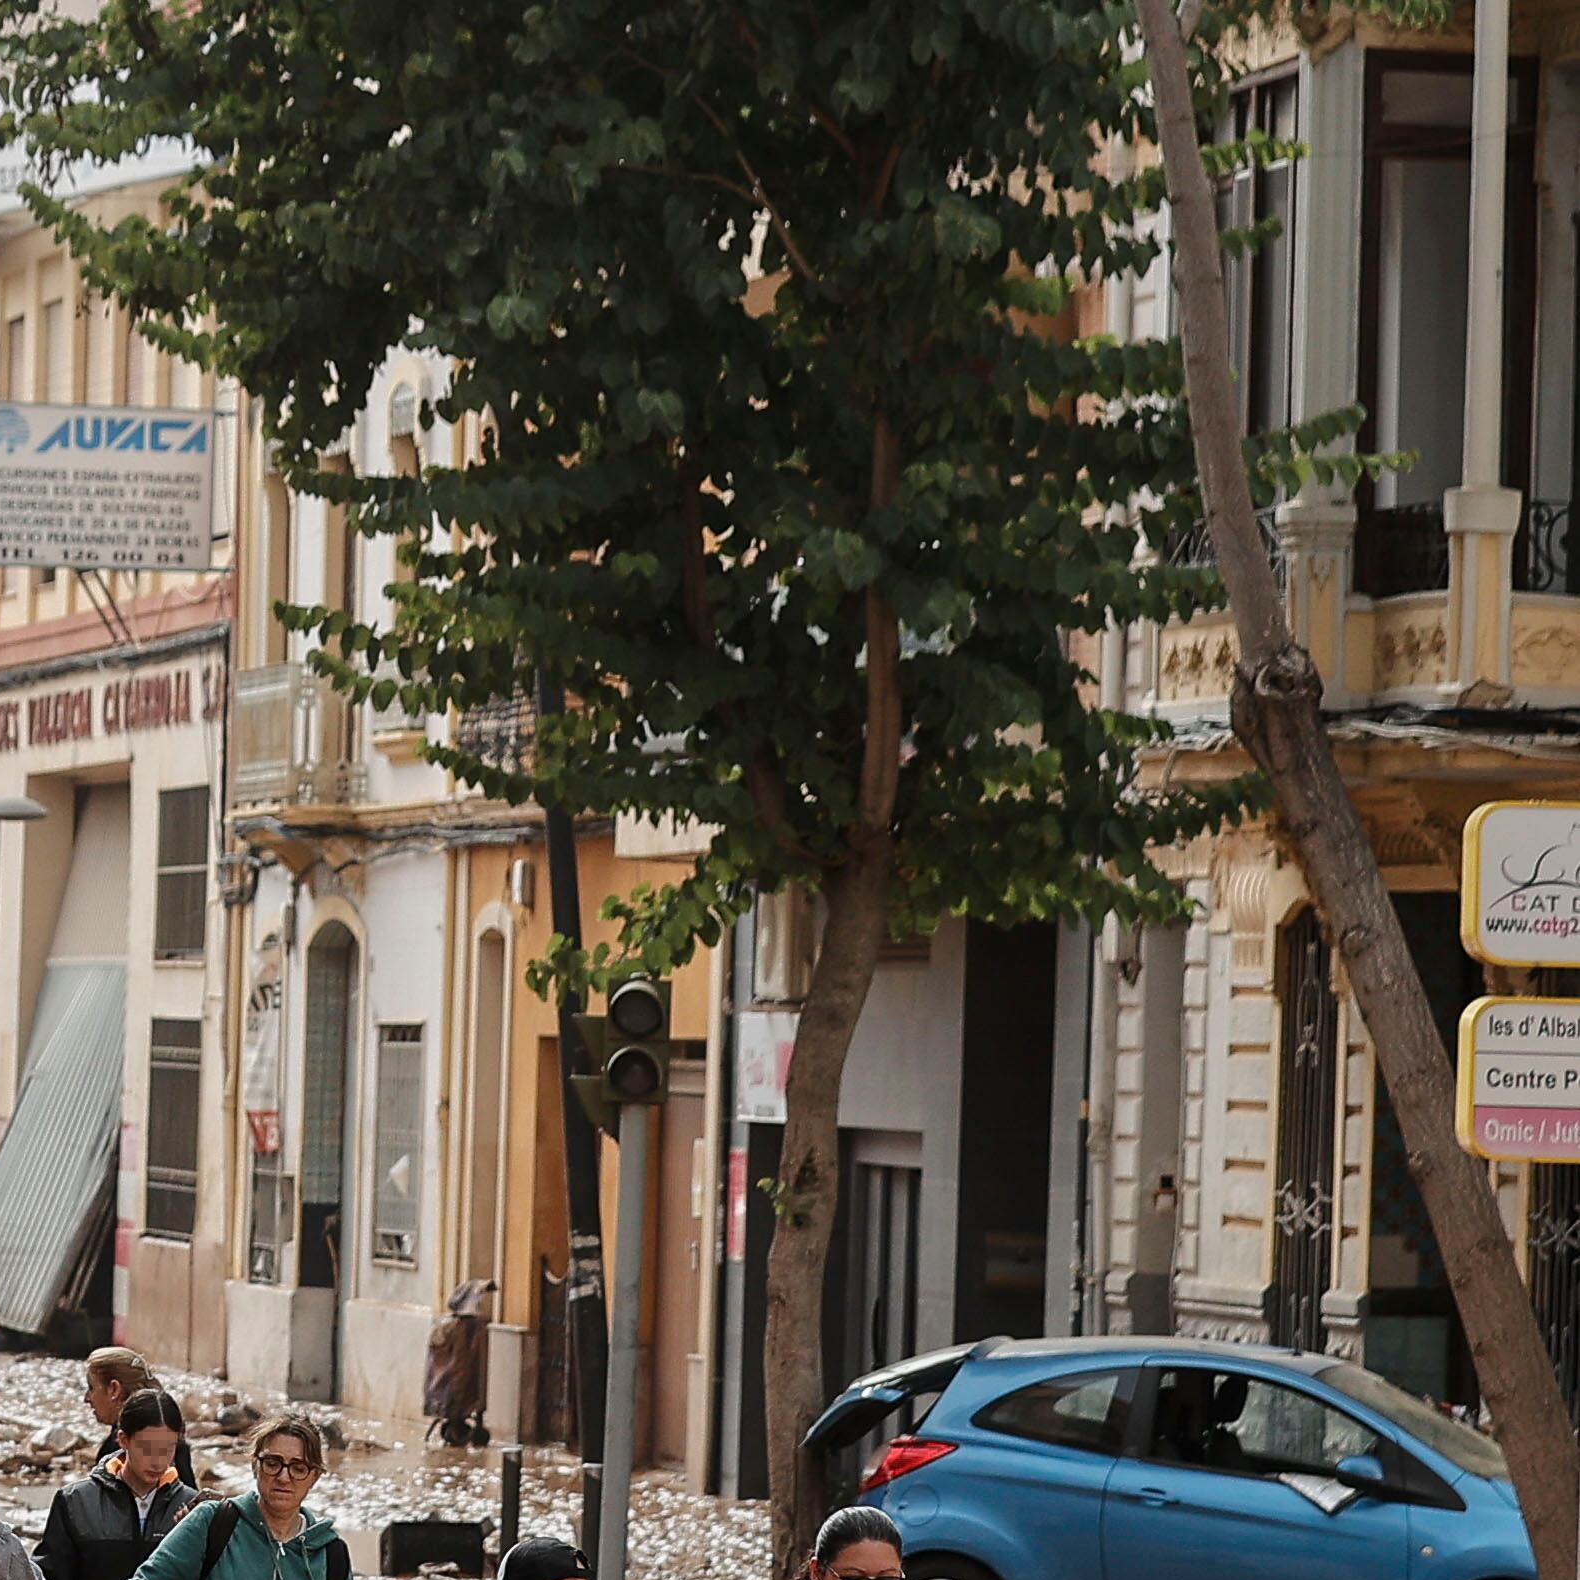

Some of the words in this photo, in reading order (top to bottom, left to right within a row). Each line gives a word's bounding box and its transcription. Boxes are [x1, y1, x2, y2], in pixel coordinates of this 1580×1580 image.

[35, 416, 208, 454] AUVACA
[1511, 894, 1561, 912] CAT
[1486, 1066, 1557, 1089] Centre
[1564, 1070, 1580, 1090] P
